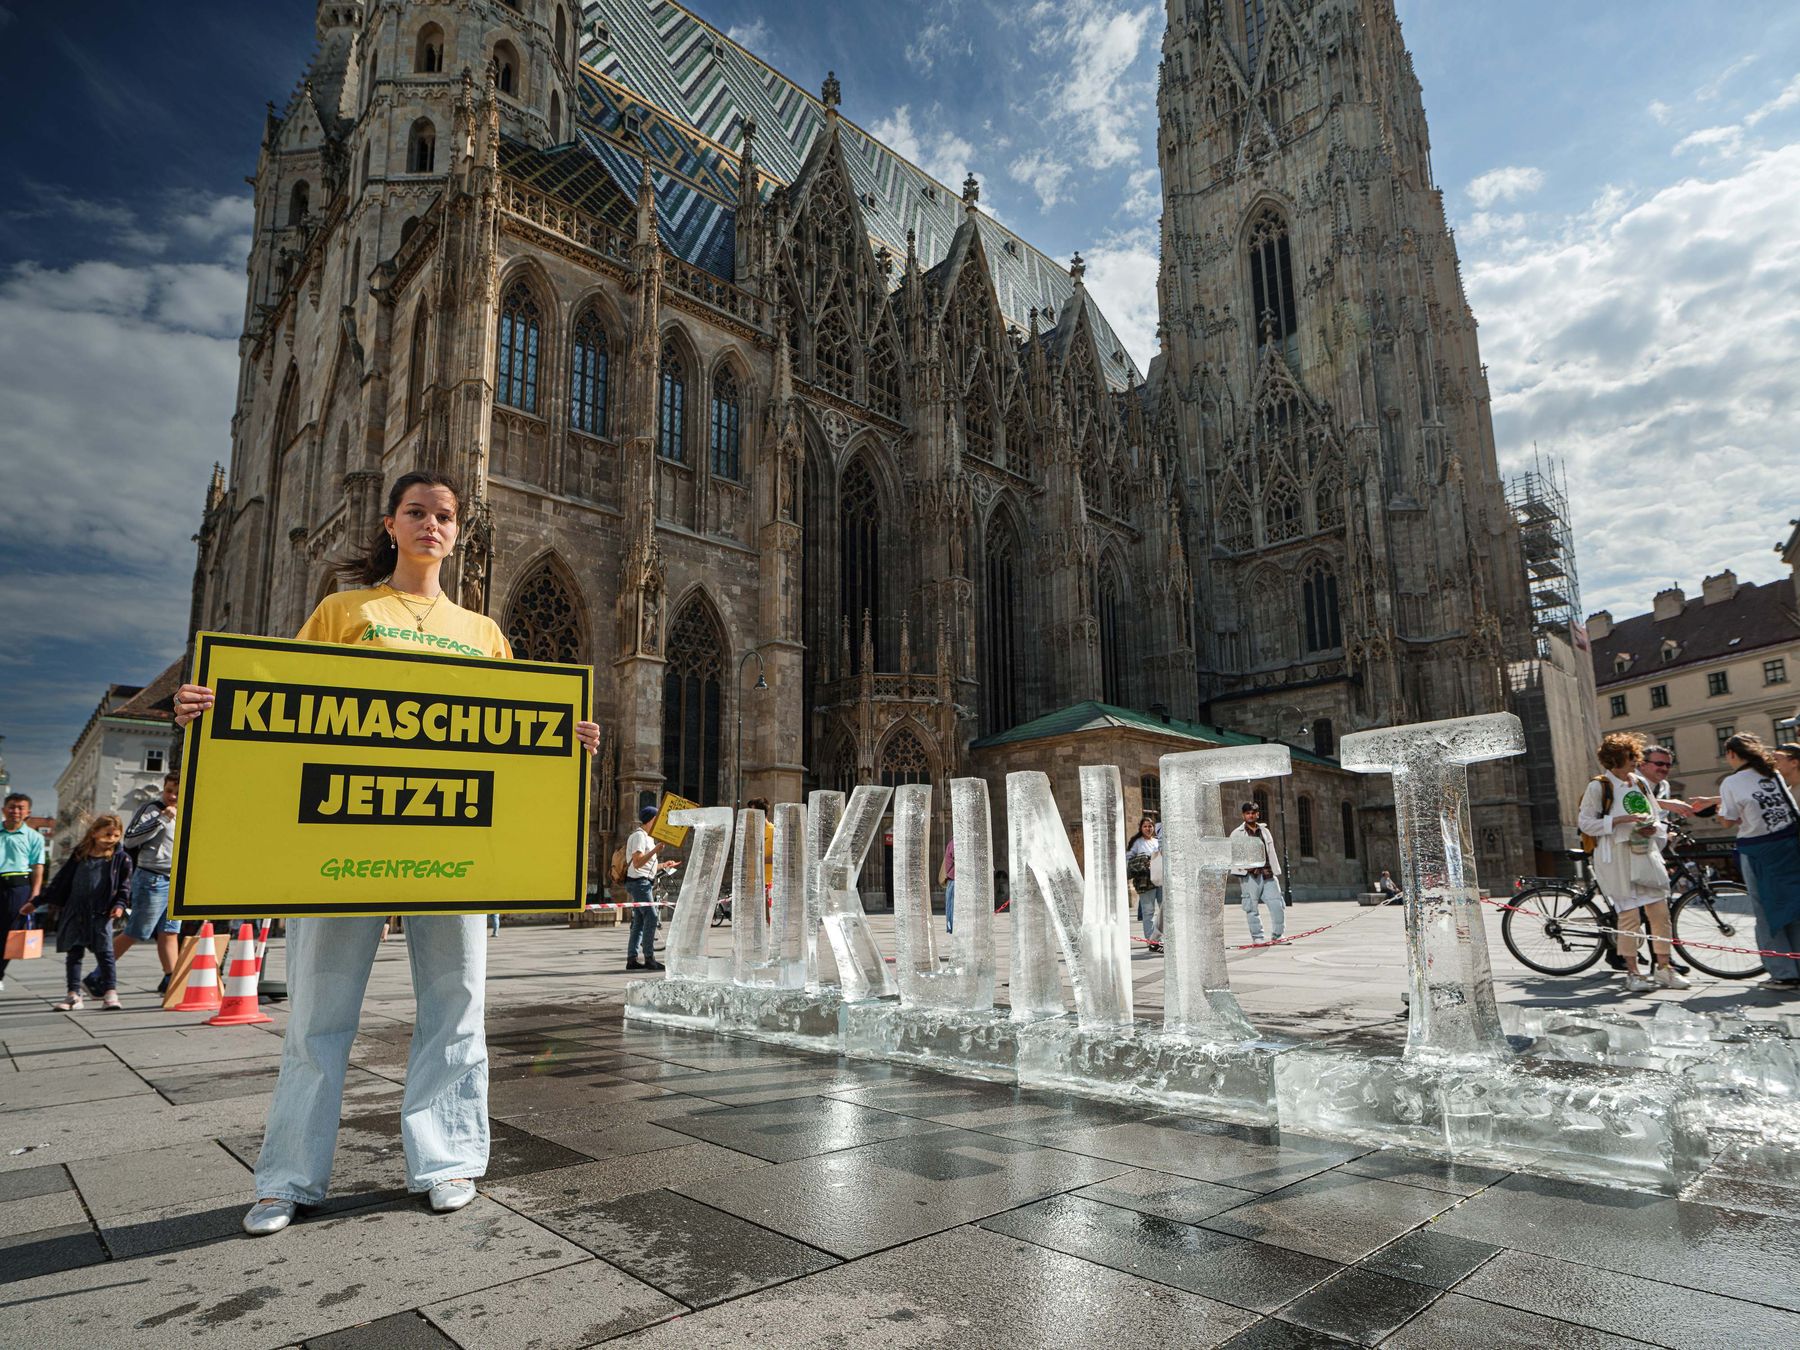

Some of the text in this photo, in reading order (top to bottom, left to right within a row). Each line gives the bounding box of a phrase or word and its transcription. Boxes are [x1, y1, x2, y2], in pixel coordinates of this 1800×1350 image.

[361, 623, 484, 657] GREENPEACE
[230, 689, 564, 748] KLIMASCHUTZ
[317, 773, 480, 819] JETZT!
[320, 857, 474, 881] GREENPEACE
